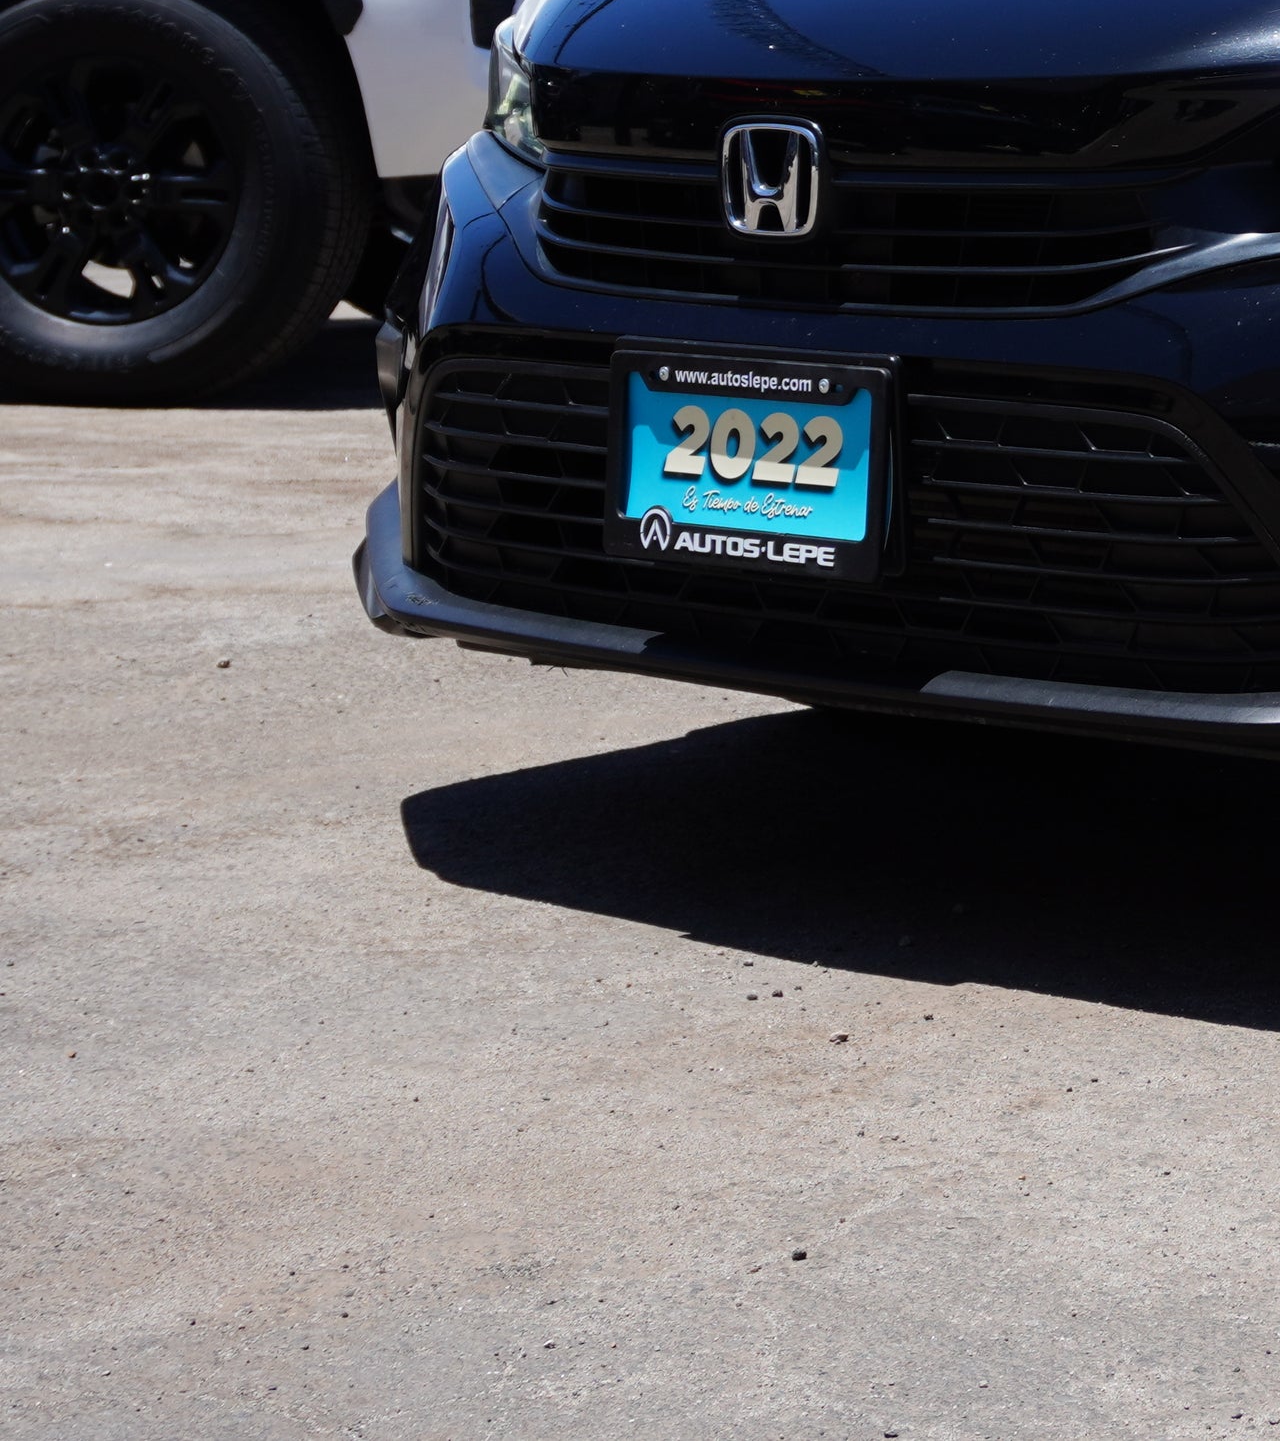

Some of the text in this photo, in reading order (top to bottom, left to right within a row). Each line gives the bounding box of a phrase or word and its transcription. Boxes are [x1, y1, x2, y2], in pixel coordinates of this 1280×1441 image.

[675, 370, 812, 393] www.autoslepe.com
[664, 405, 843, 488] 2022
[682, 485, 814, 519] Es Tiempo de Estrenar
